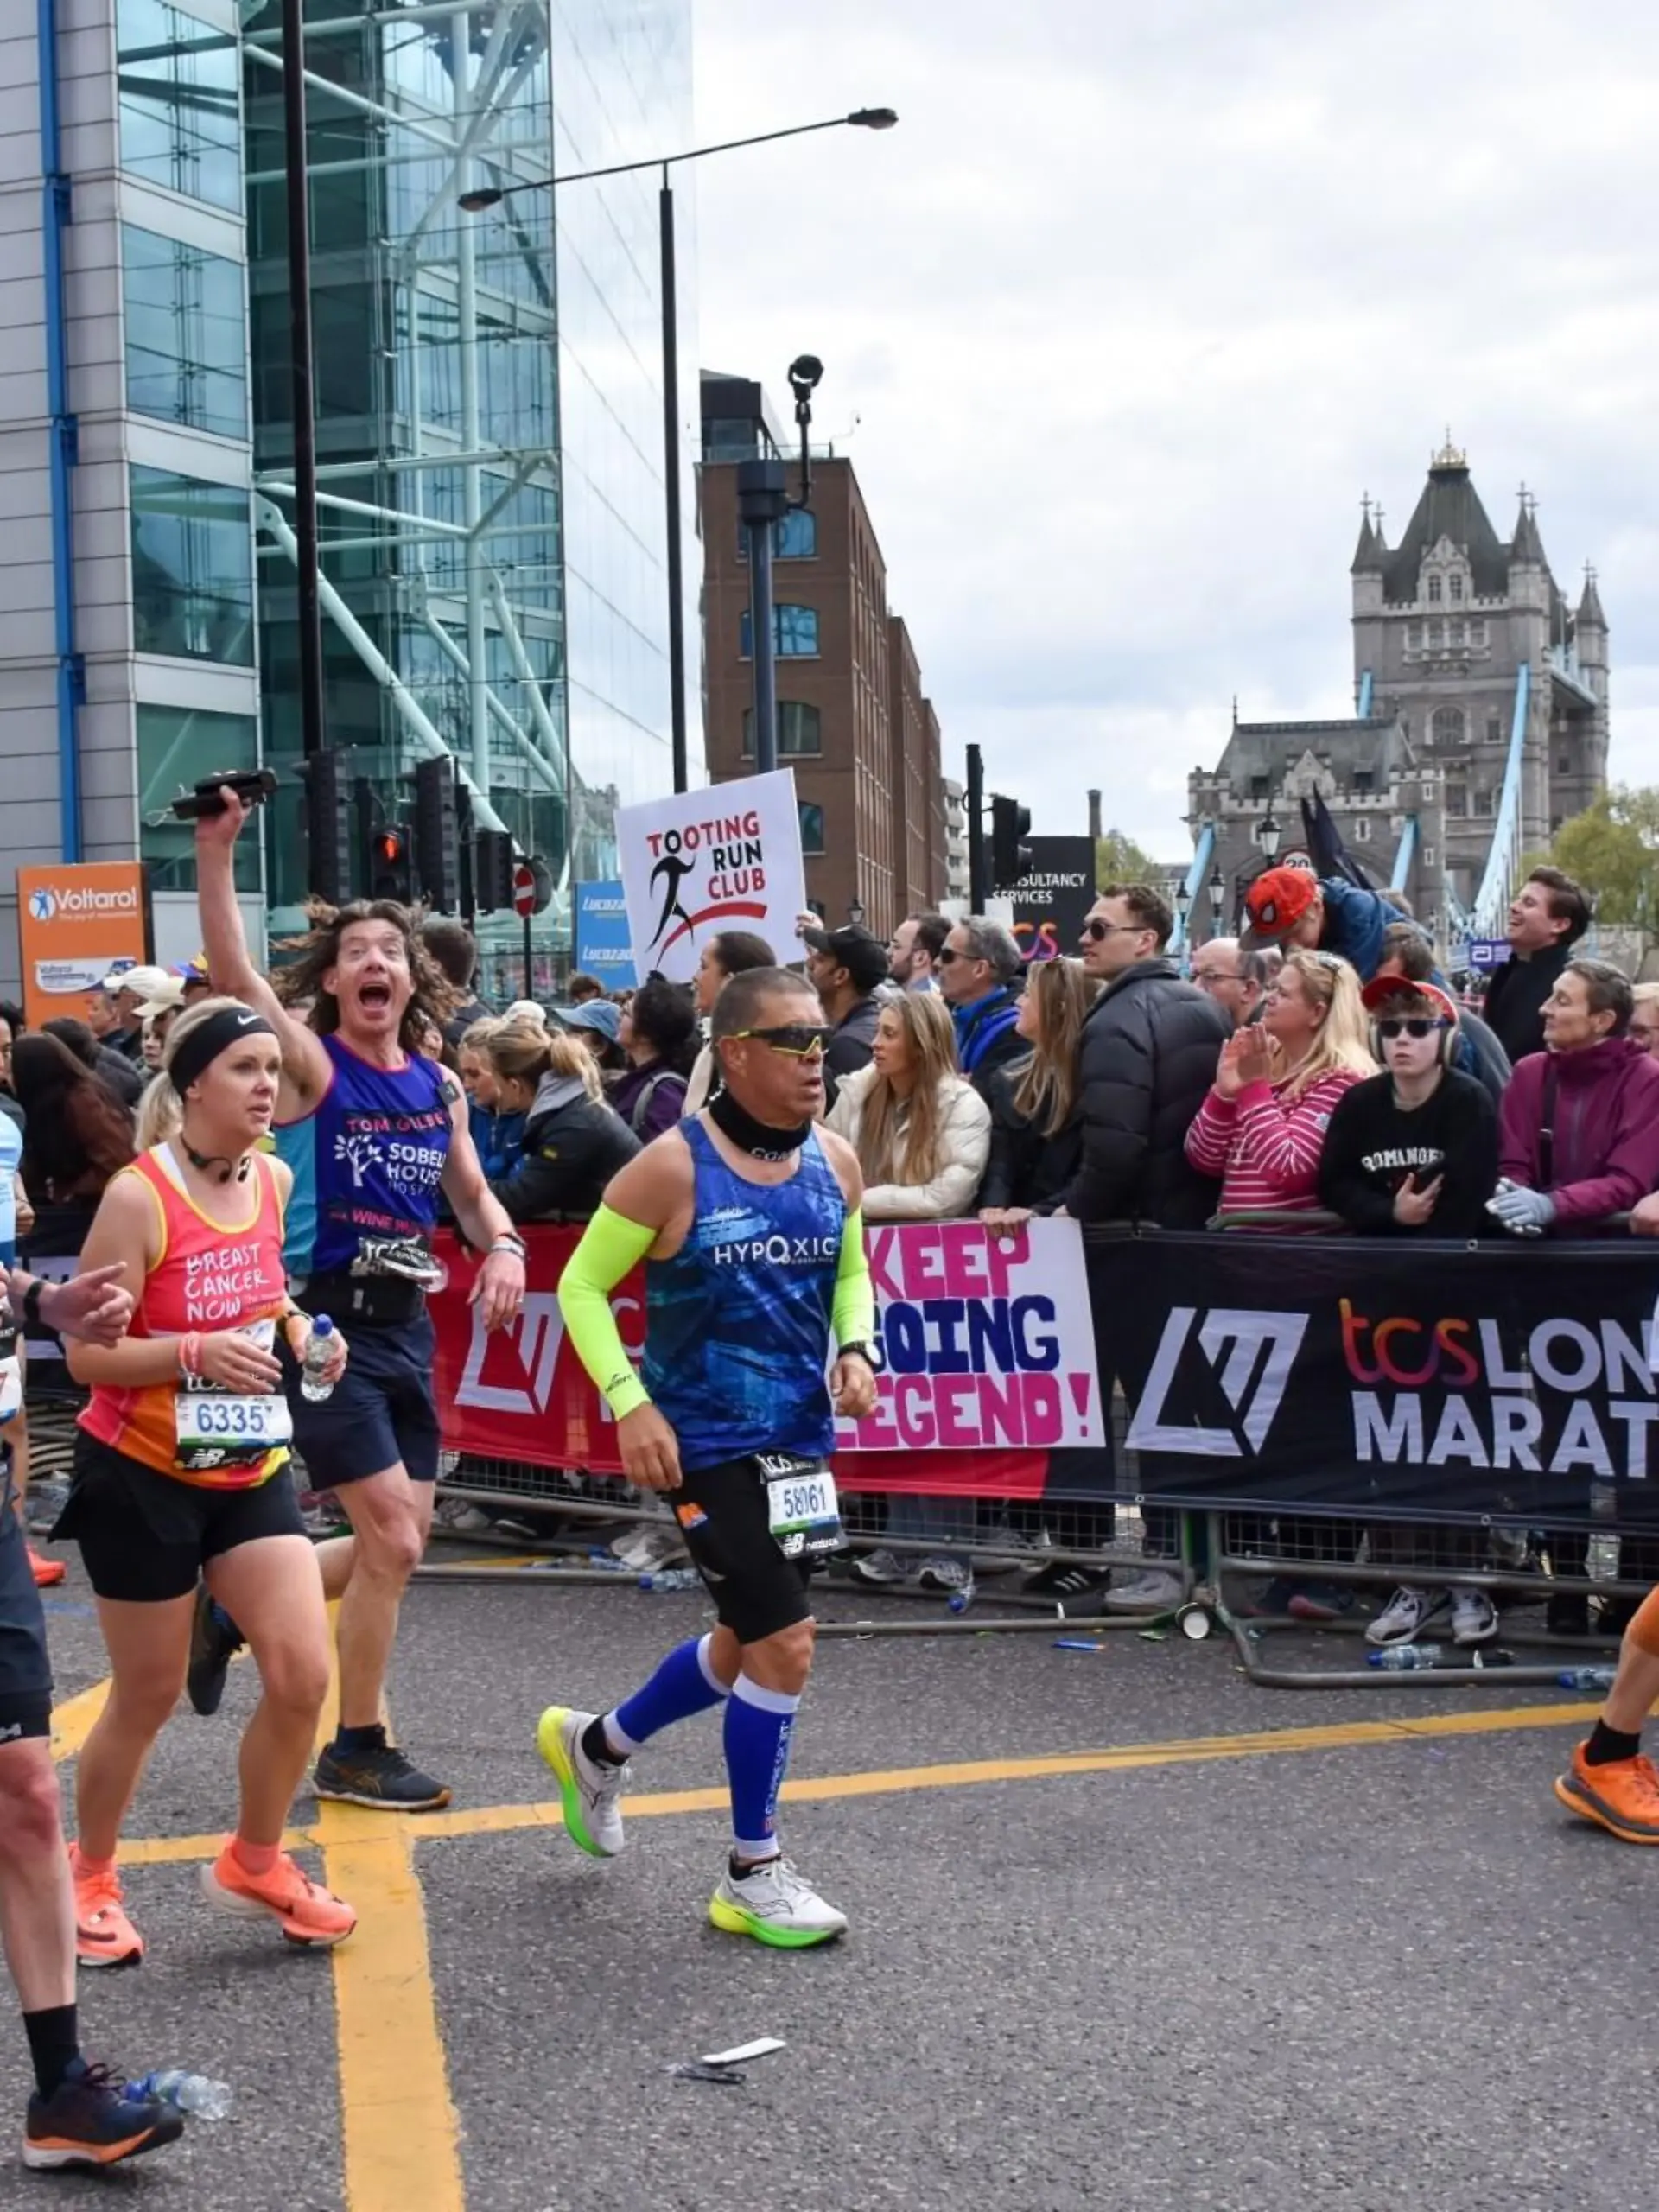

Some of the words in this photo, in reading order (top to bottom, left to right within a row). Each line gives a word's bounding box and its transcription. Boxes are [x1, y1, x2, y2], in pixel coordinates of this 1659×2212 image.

[646, 810, 760, 857] TOOTING
[712, 839, 763, 873] RUN
[708, 868, 766, 900] CLUB
[995, 873, 1087, 887] SULTANCY
[54, 887, 137, 911] Voltarol
[347, 1118, 390, 1133] TOM
[386, 1162, 442, 1185] HOUS
[186, 1243, 261, 1276] BREAST
[715, 1235, 836, 1266] HYPOXIC
[863, 1220, 1030, 1300] KEEP
[184, 1268, 270, 1300] CANCER
[187, 1296, 241, 1323] NOW
[1351, 1390, 1659, 1478] MARAT
